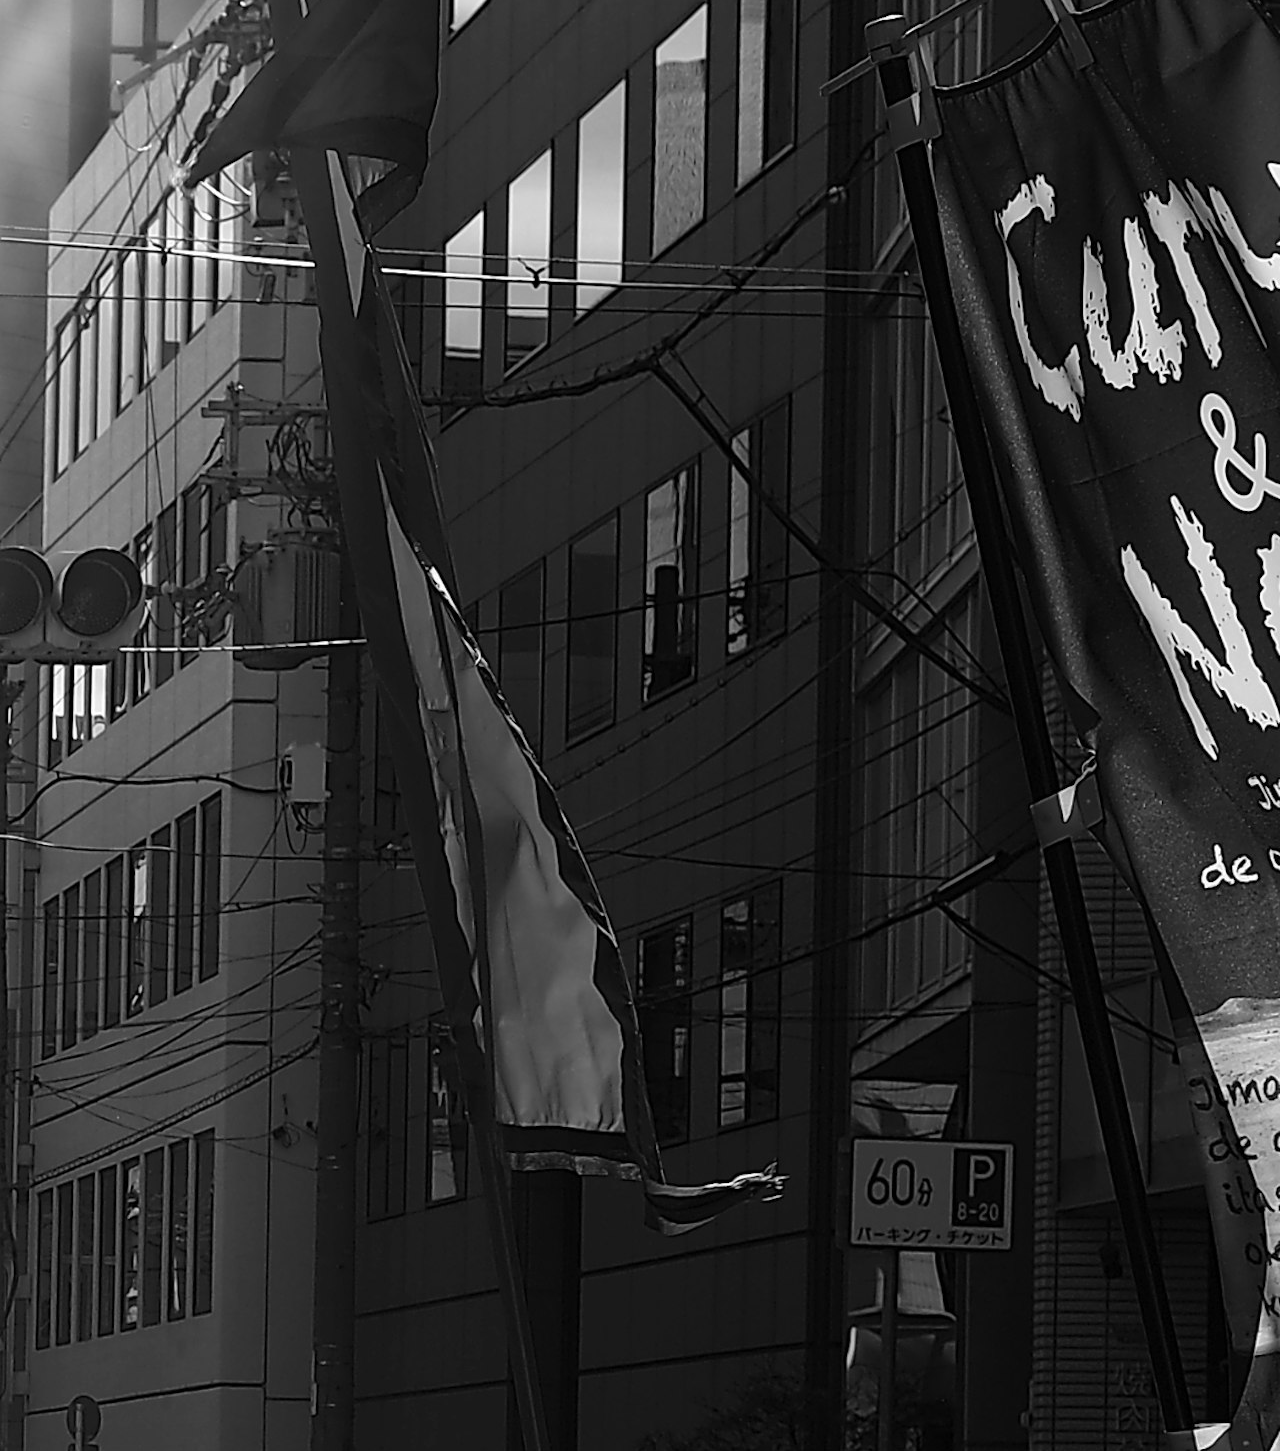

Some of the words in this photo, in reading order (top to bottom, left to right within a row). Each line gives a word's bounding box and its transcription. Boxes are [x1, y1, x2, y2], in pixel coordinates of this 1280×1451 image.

[1200, 842, 1259, 890] de
[867, 1158, 933, 1206] 60分
[968, 1155, 996, 1197] P
[957, 1201, 1000, 1222] 8-20
[856, 1227, 1004, 1246] パーキング・チケット
